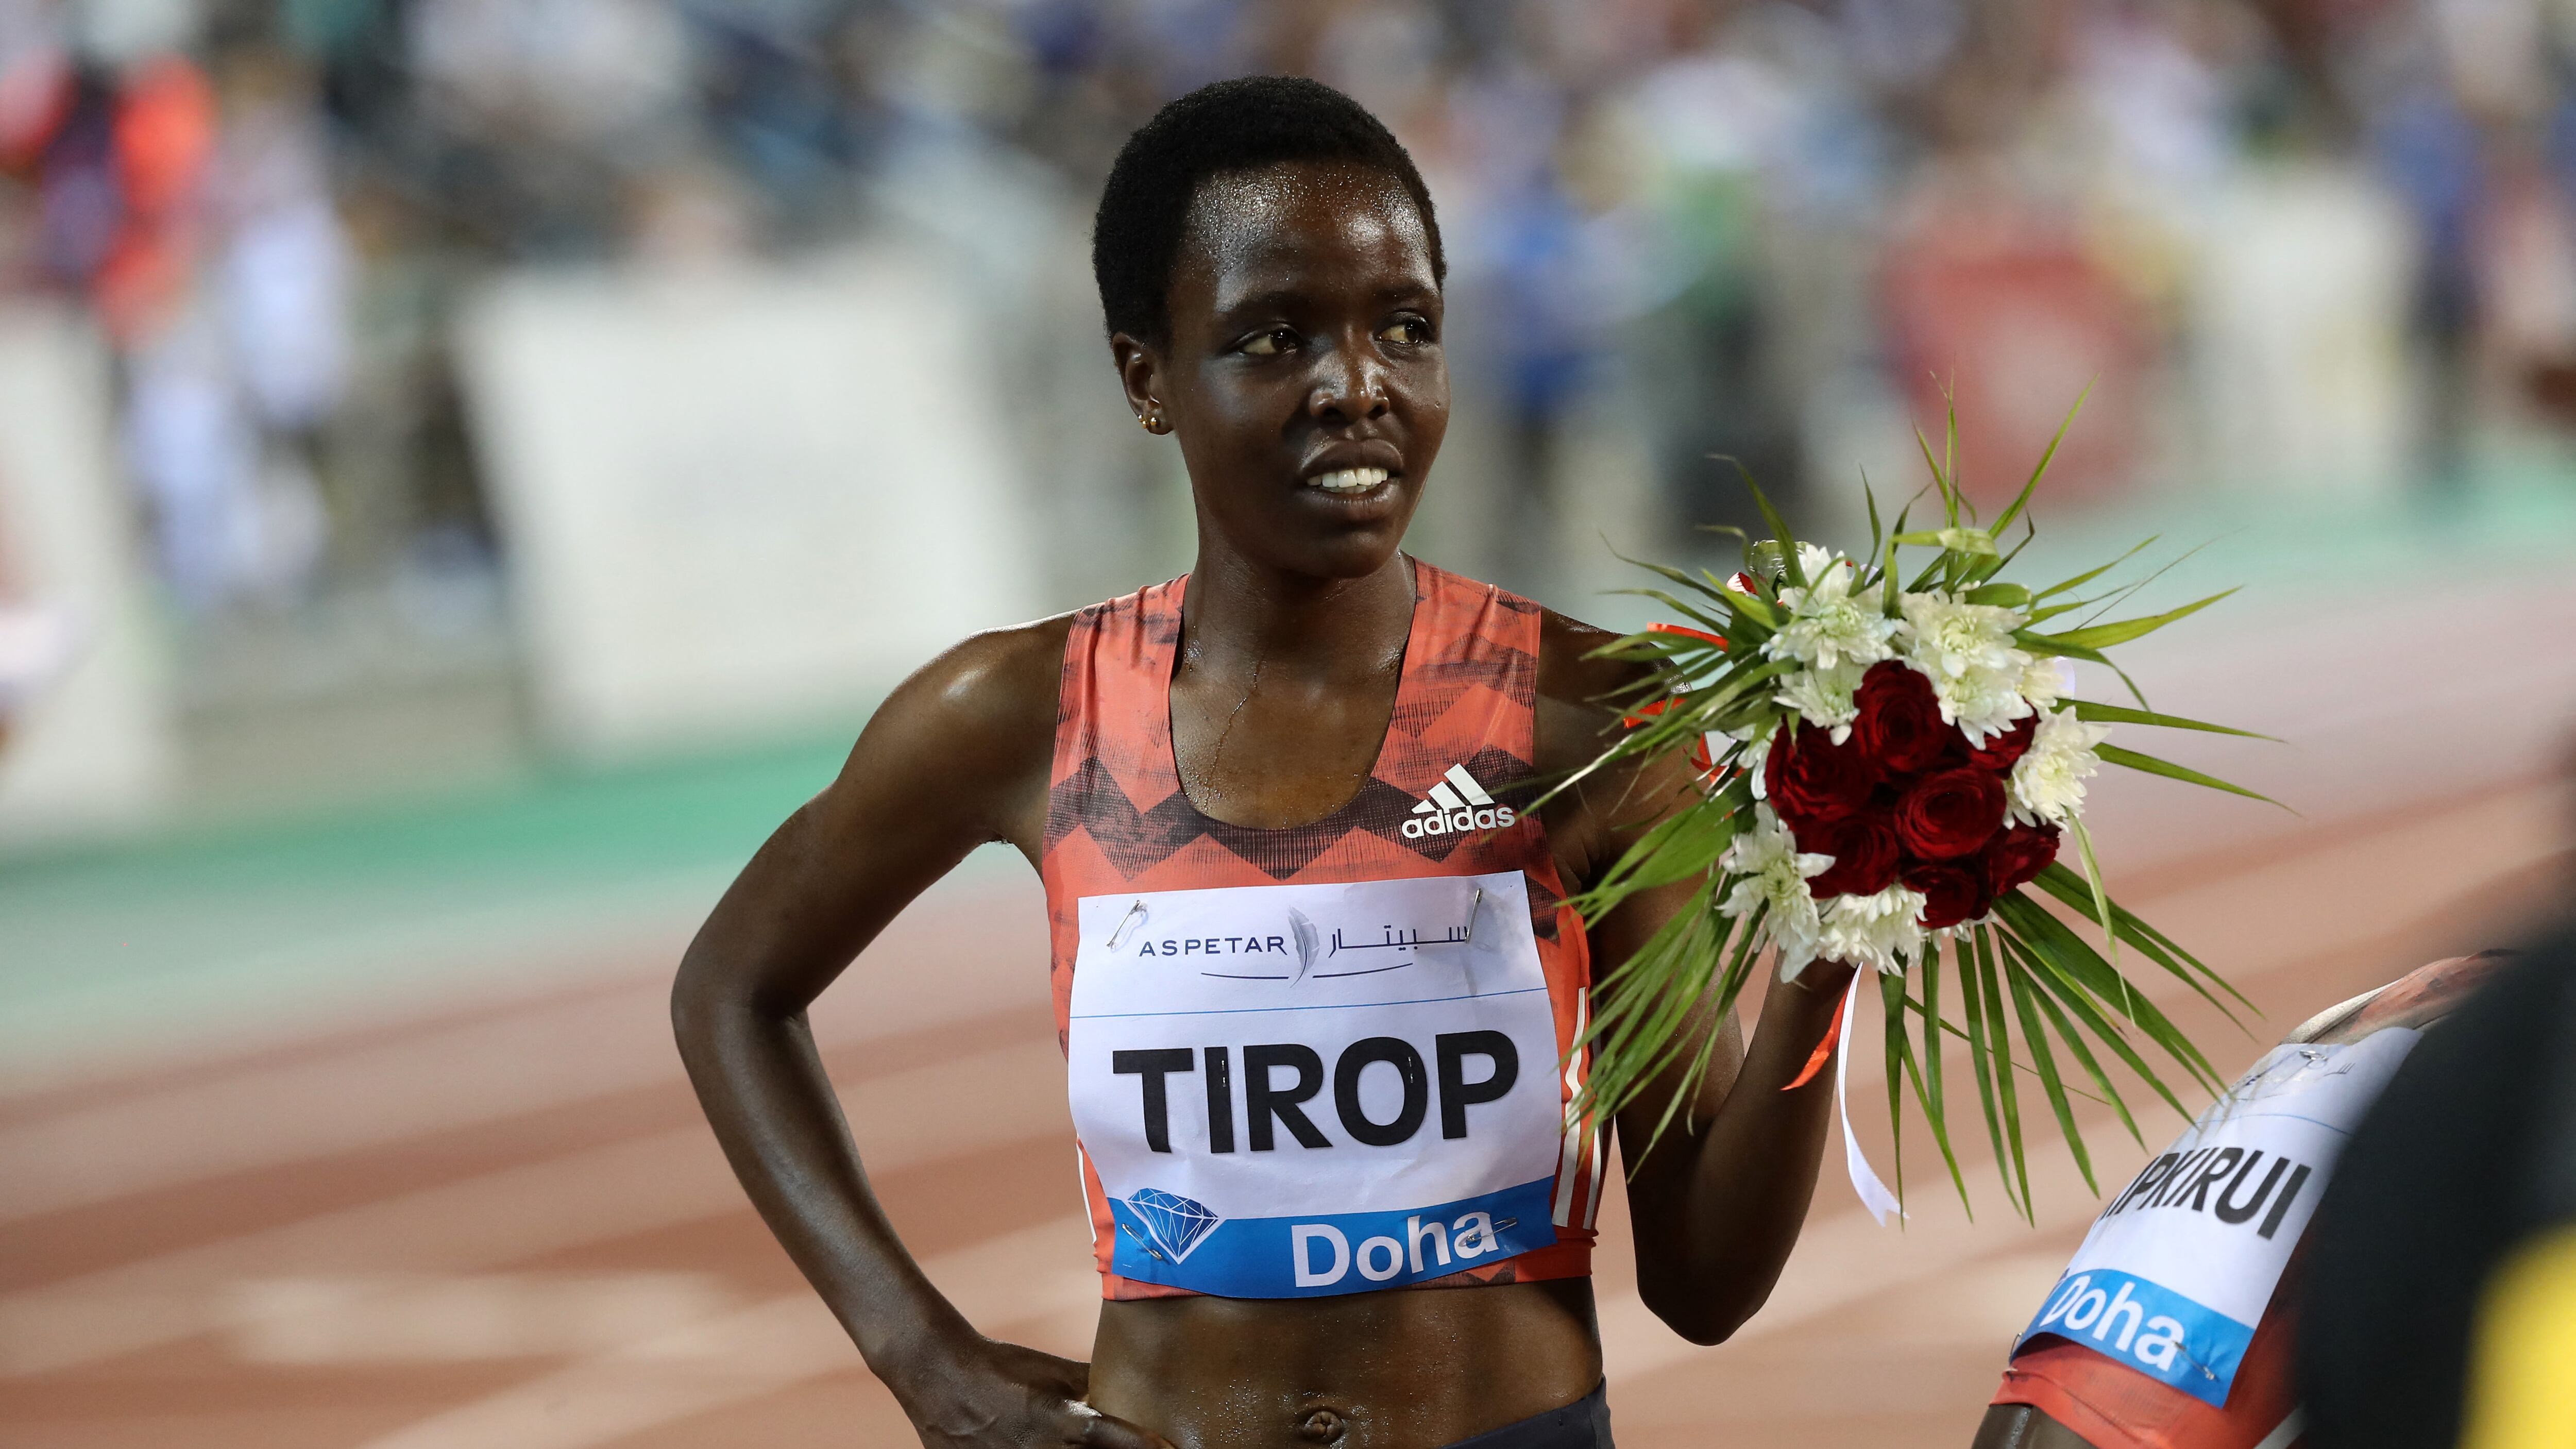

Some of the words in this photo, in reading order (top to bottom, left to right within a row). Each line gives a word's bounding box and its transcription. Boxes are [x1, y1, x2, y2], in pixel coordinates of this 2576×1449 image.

[1401, 805, 1516, 839] adidas
[1139, 936, 1287, 957] ASPETAR
[1113, 1030, 1518, 1154] TIROP
[2098, 1147, 2312, 1240] IPKIRUI
[1291, 1211, 1499, 1287] Doha
[2039, 1275, 2184, 1372] Doha
